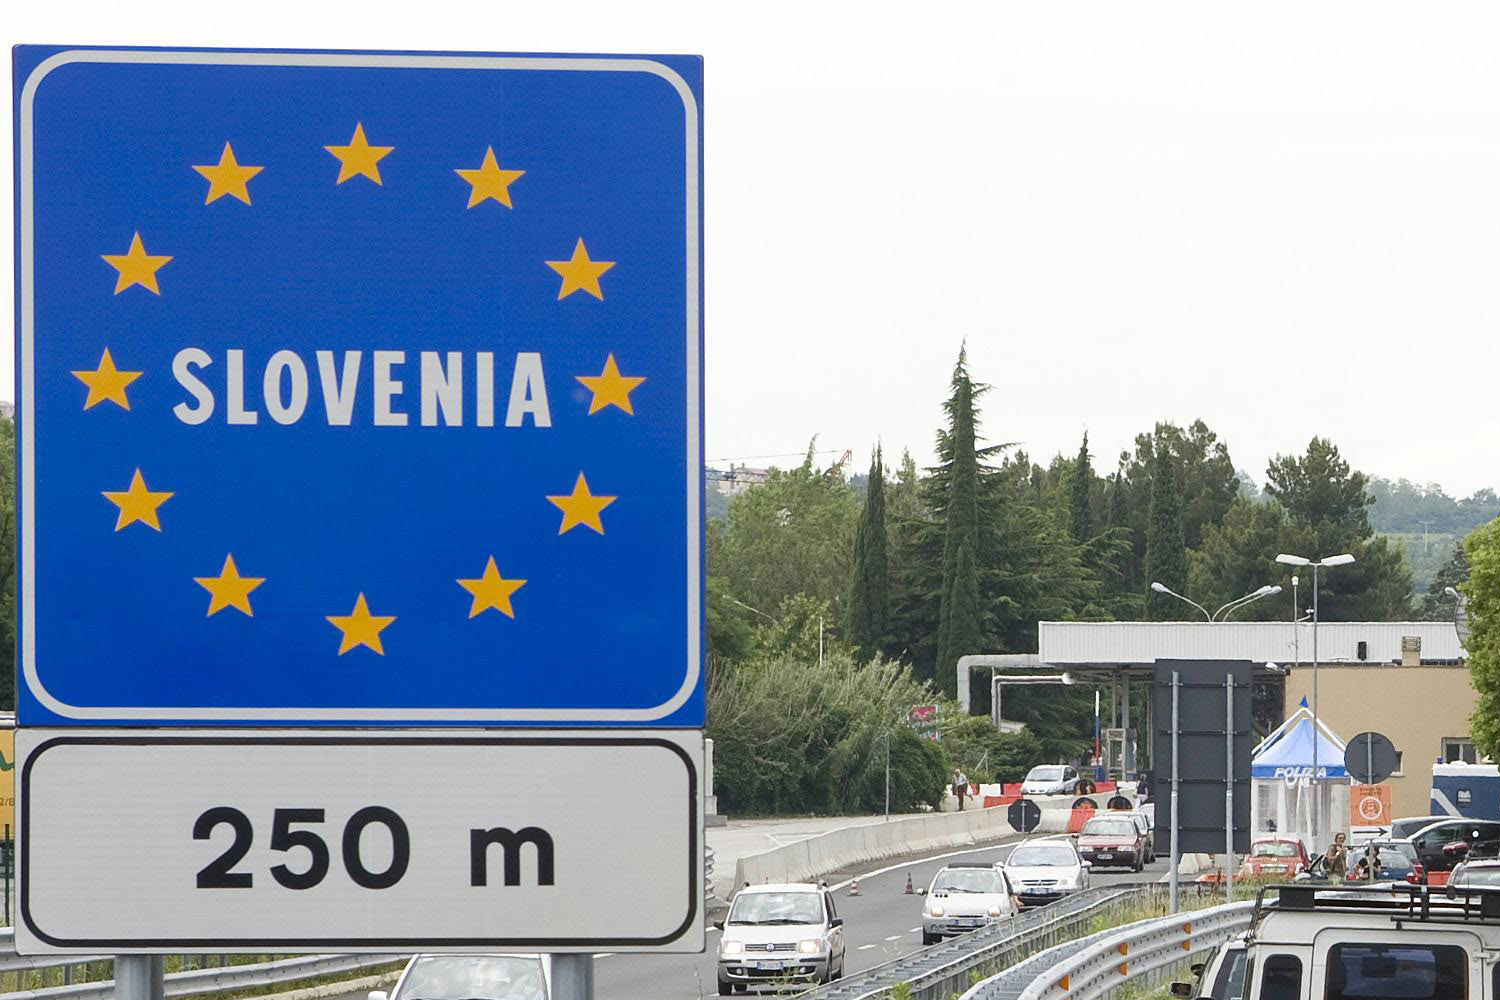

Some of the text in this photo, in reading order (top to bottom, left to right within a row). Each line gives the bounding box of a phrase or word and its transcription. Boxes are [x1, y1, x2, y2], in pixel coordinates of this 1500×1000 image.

[172, 347, 552, 428] SLOVENIA
[1274, 767, 1327, 778] POLIZA
[192, 805, 556, 891] 250 m
